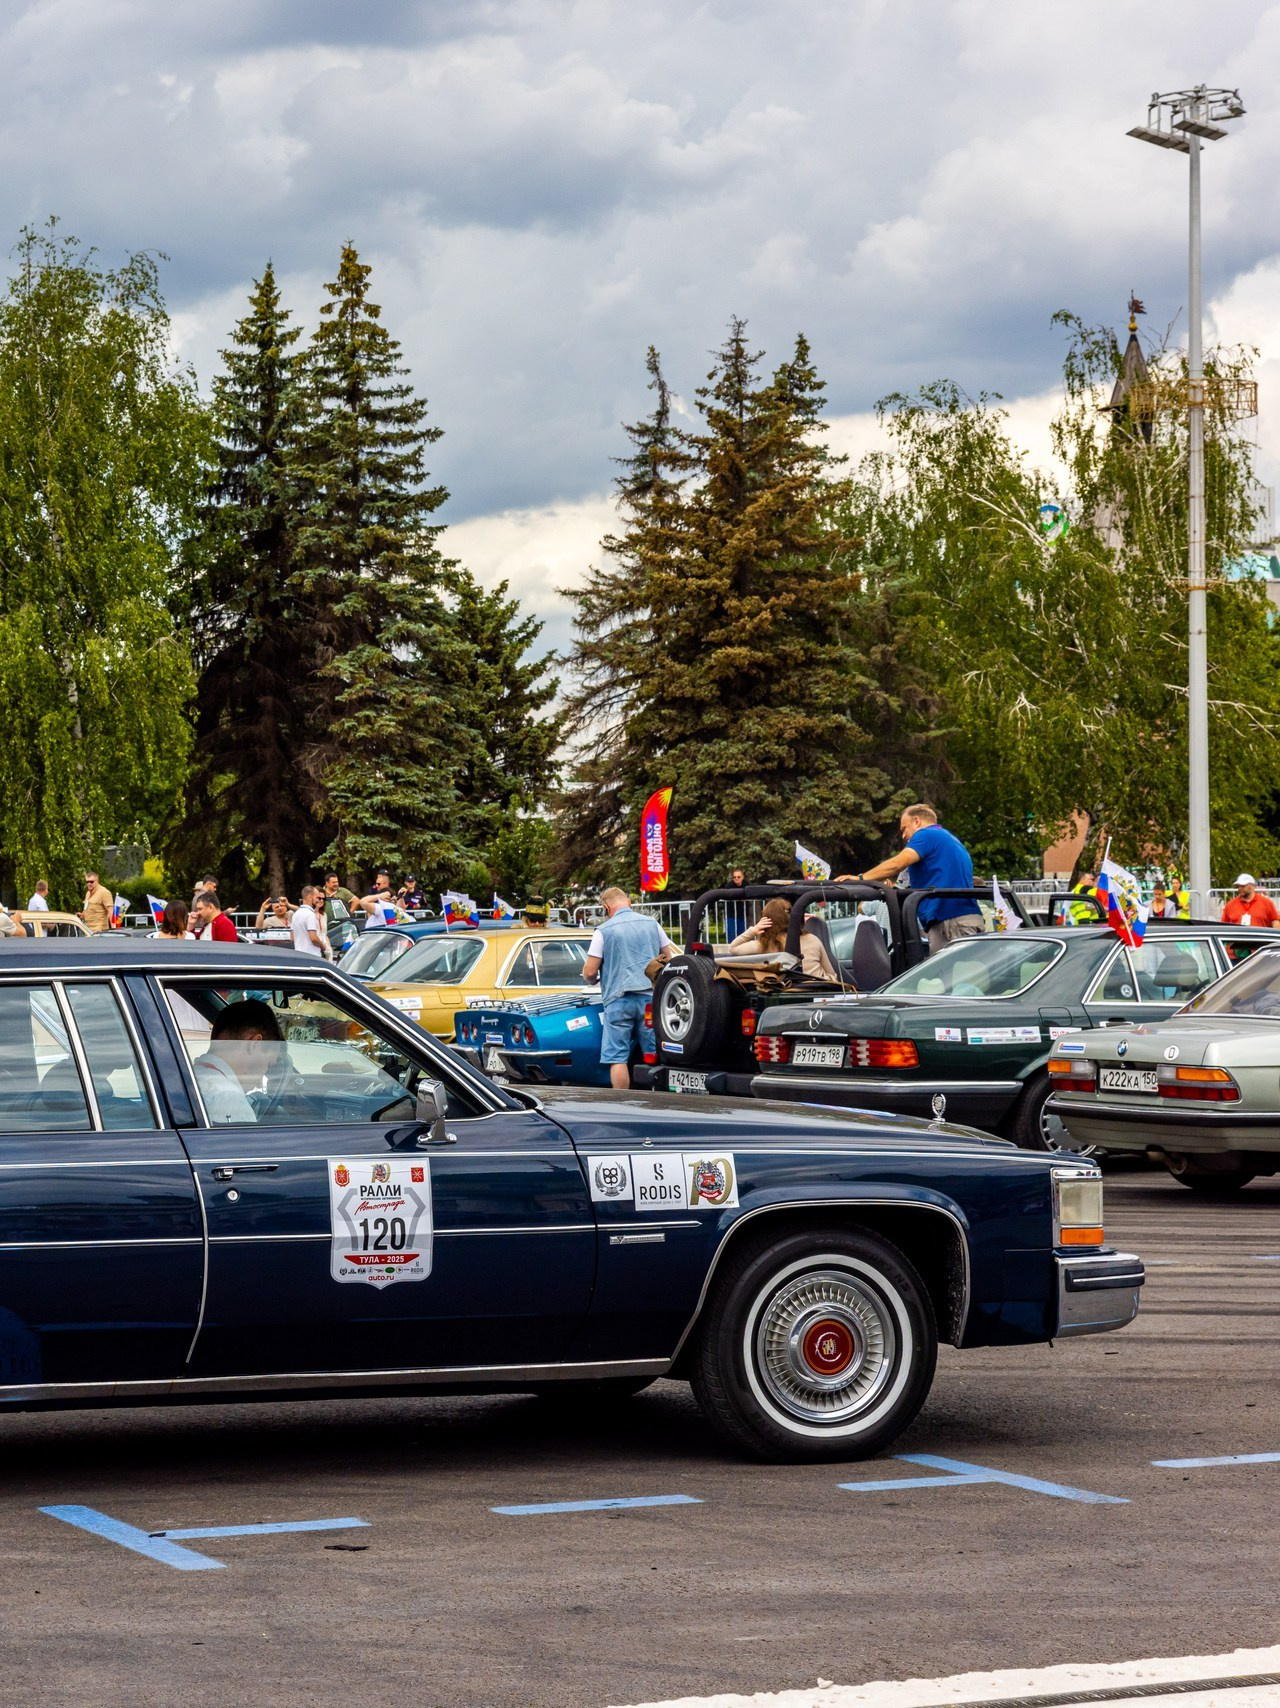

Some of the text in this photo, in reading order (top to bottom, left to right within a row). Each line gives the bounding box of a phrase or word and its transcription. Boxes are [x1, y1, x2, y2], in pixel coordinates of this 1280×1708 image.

[647, 837, 655, 872] АЛЬФА
[653, 823, 664, 873] ВЫГОДНО
[828, 1048, 841, 1060] 198
[1103, 1071, 1157, 1088] К222КА 150
[360, 1184, 401, 1197] РАЛЛИ
[640, 1184, 682, 1200] RODIS
[354, 1200, 406, 1215] Автострада
[359, 1217, 406, 1251] 120
[359, 1256, 379, 1264] ТУЛА
[387, 1255, 405, 1263] 2025
